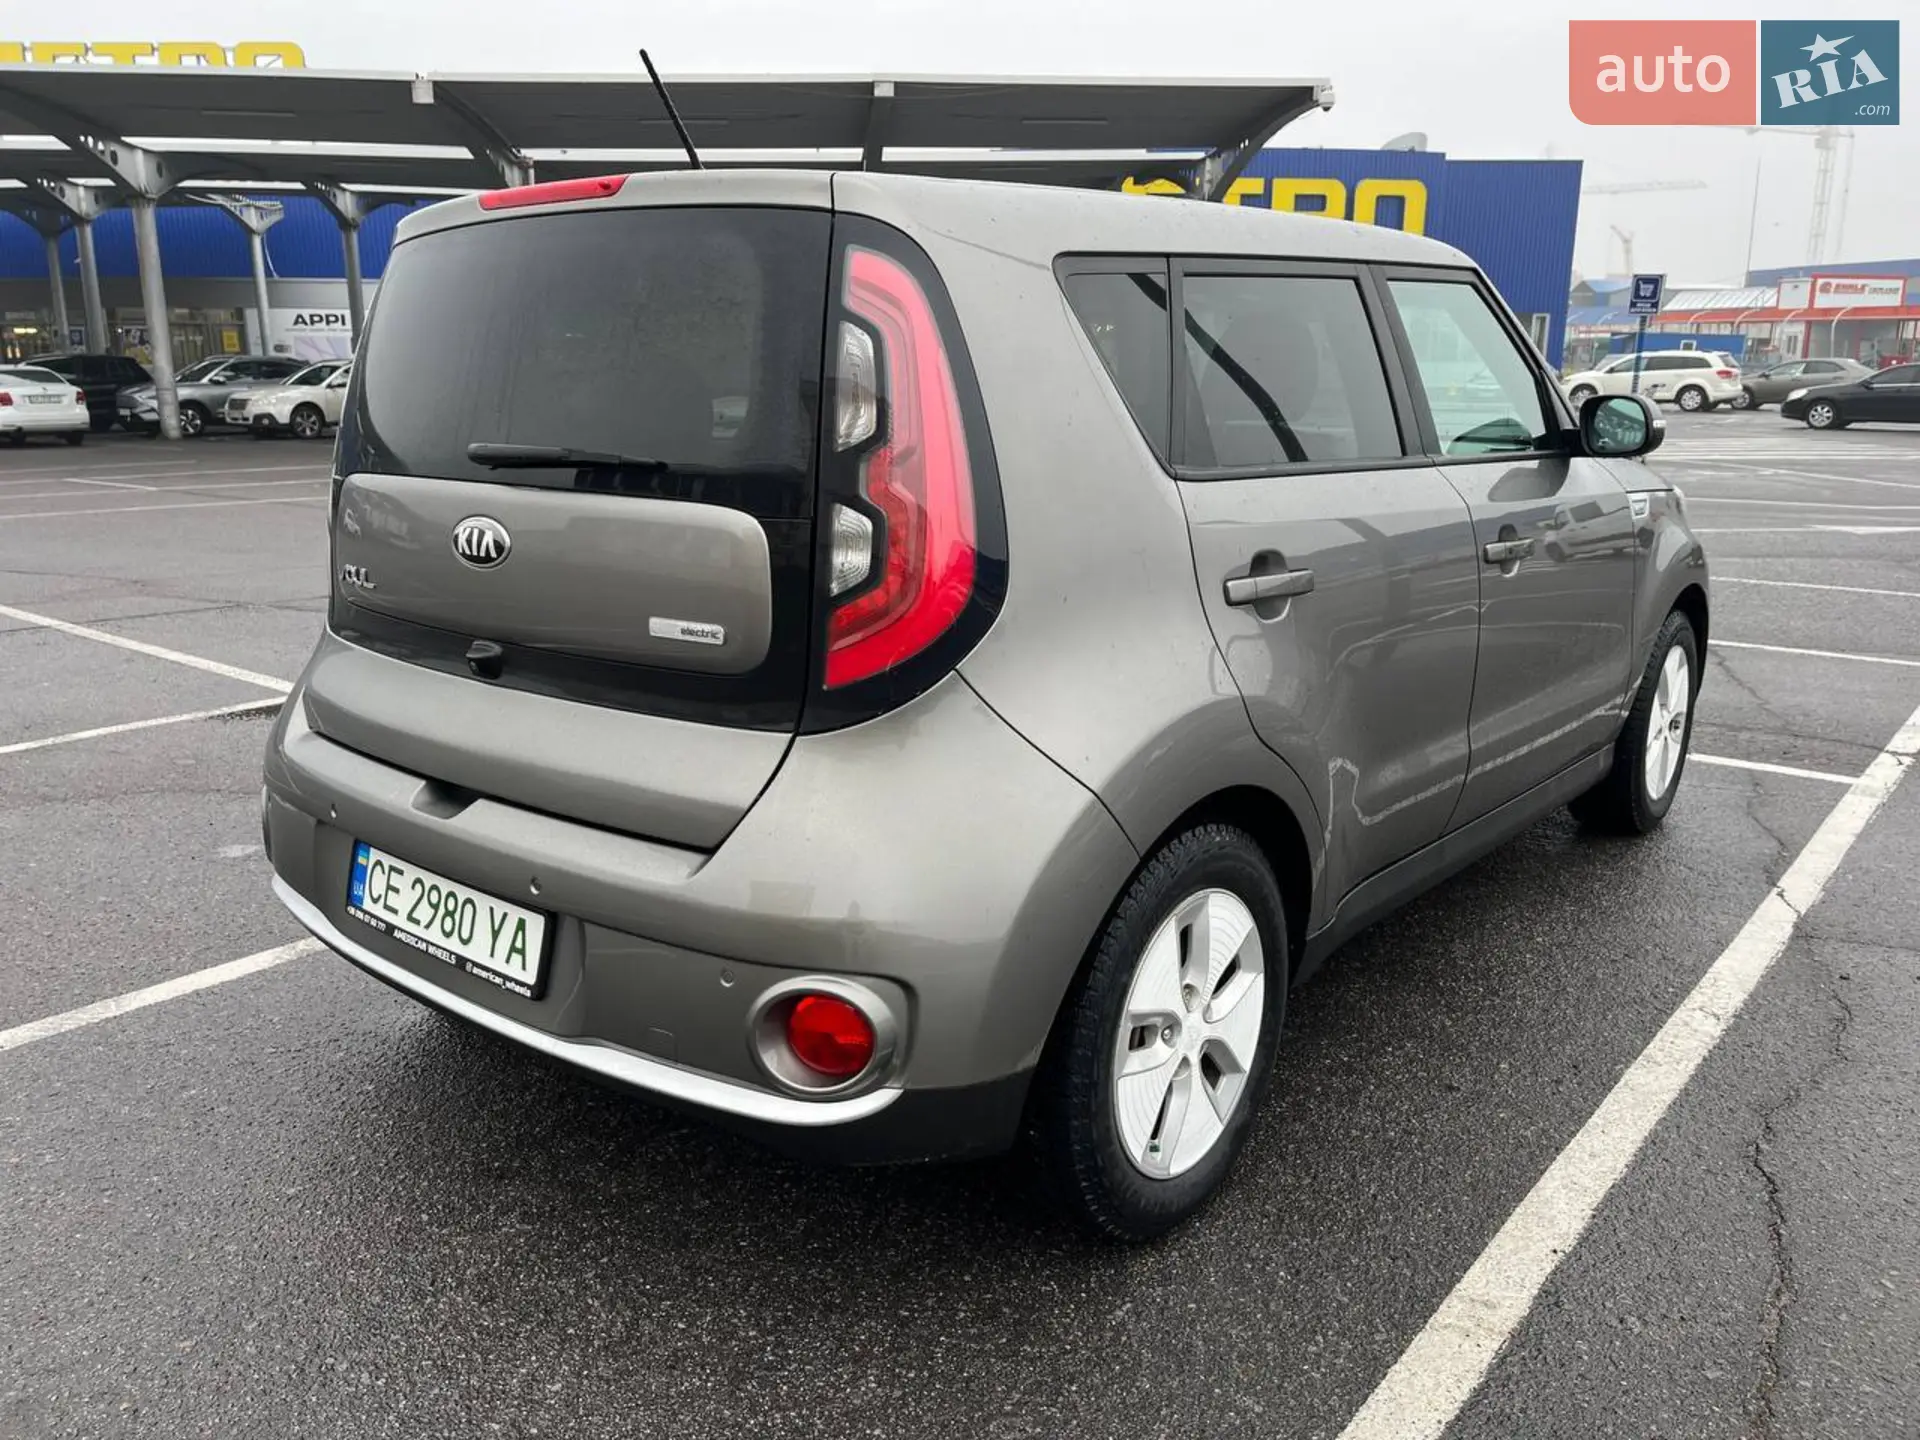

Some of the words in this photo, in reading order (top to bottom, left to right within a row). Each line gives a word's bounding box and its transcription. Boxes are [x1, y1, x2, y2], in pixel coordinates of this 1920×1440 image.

[457, 525, 498, 559] KIA
[680, 626, 721, 641] electric
[368, 859, 404, 915] CE
[406, 877, 477, 946] 2980
[489, 905, 527, 971] YA
[393, 928, 427, 953] AMERICAN
[427, 944, 456, 964] WHEELS
